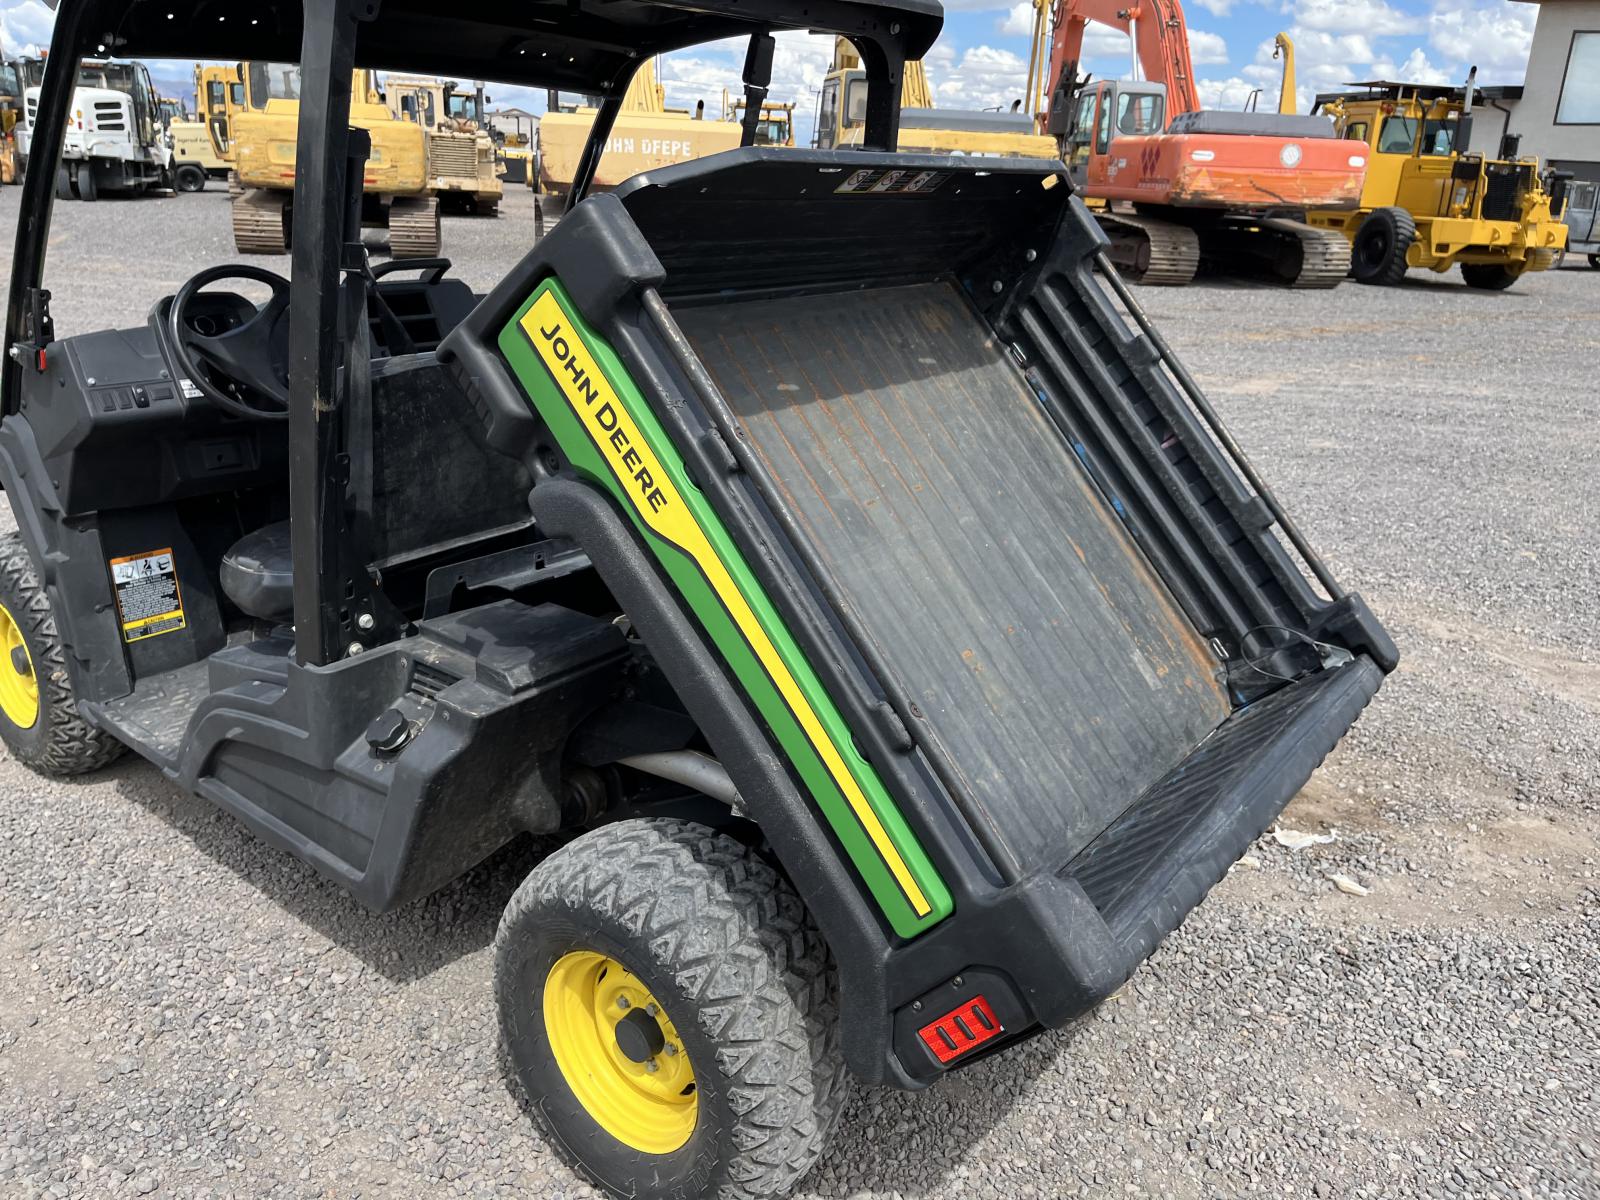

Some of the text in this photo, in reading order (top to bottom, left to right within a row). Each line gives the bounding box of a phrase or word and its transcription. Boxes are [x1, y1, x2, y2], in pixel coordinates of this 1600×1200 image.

[603, 137, 634, 154] OHN
[540, 323, 668, 514] JOHN DEERE
